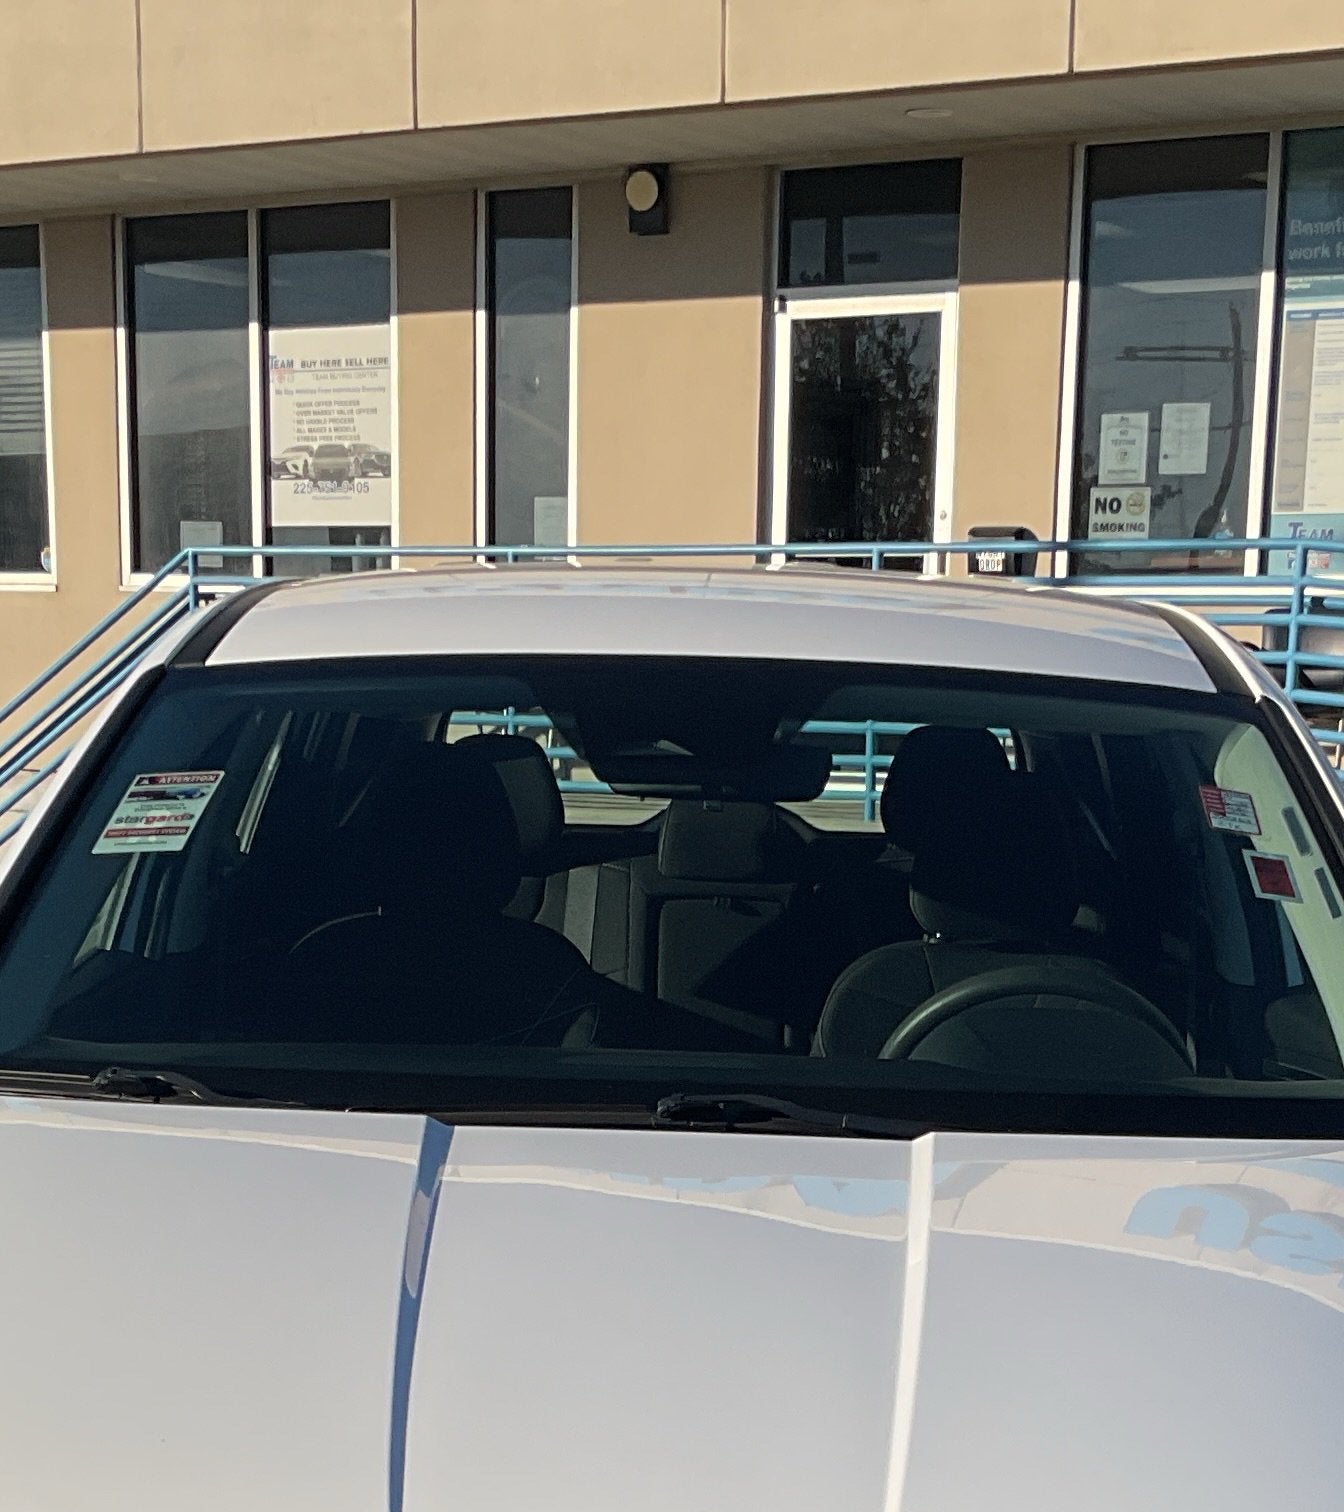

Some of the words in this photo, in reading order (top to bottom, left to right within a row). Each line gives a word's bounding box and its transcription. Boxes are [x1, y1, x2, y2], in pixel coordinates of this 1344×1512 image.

[1287, 244, 1330, 260] work
[300, 360, 317, 369] BUY
[319, 359, 342, 368] HERE
[345, 358, 364, 367] SELL
[366, 357, 389, 366] HERE
[1094, 497, 1122, 515] NO
[1092, 522, 1146, 533] SMOKING
[979, 559, 1001, 571] DROP
